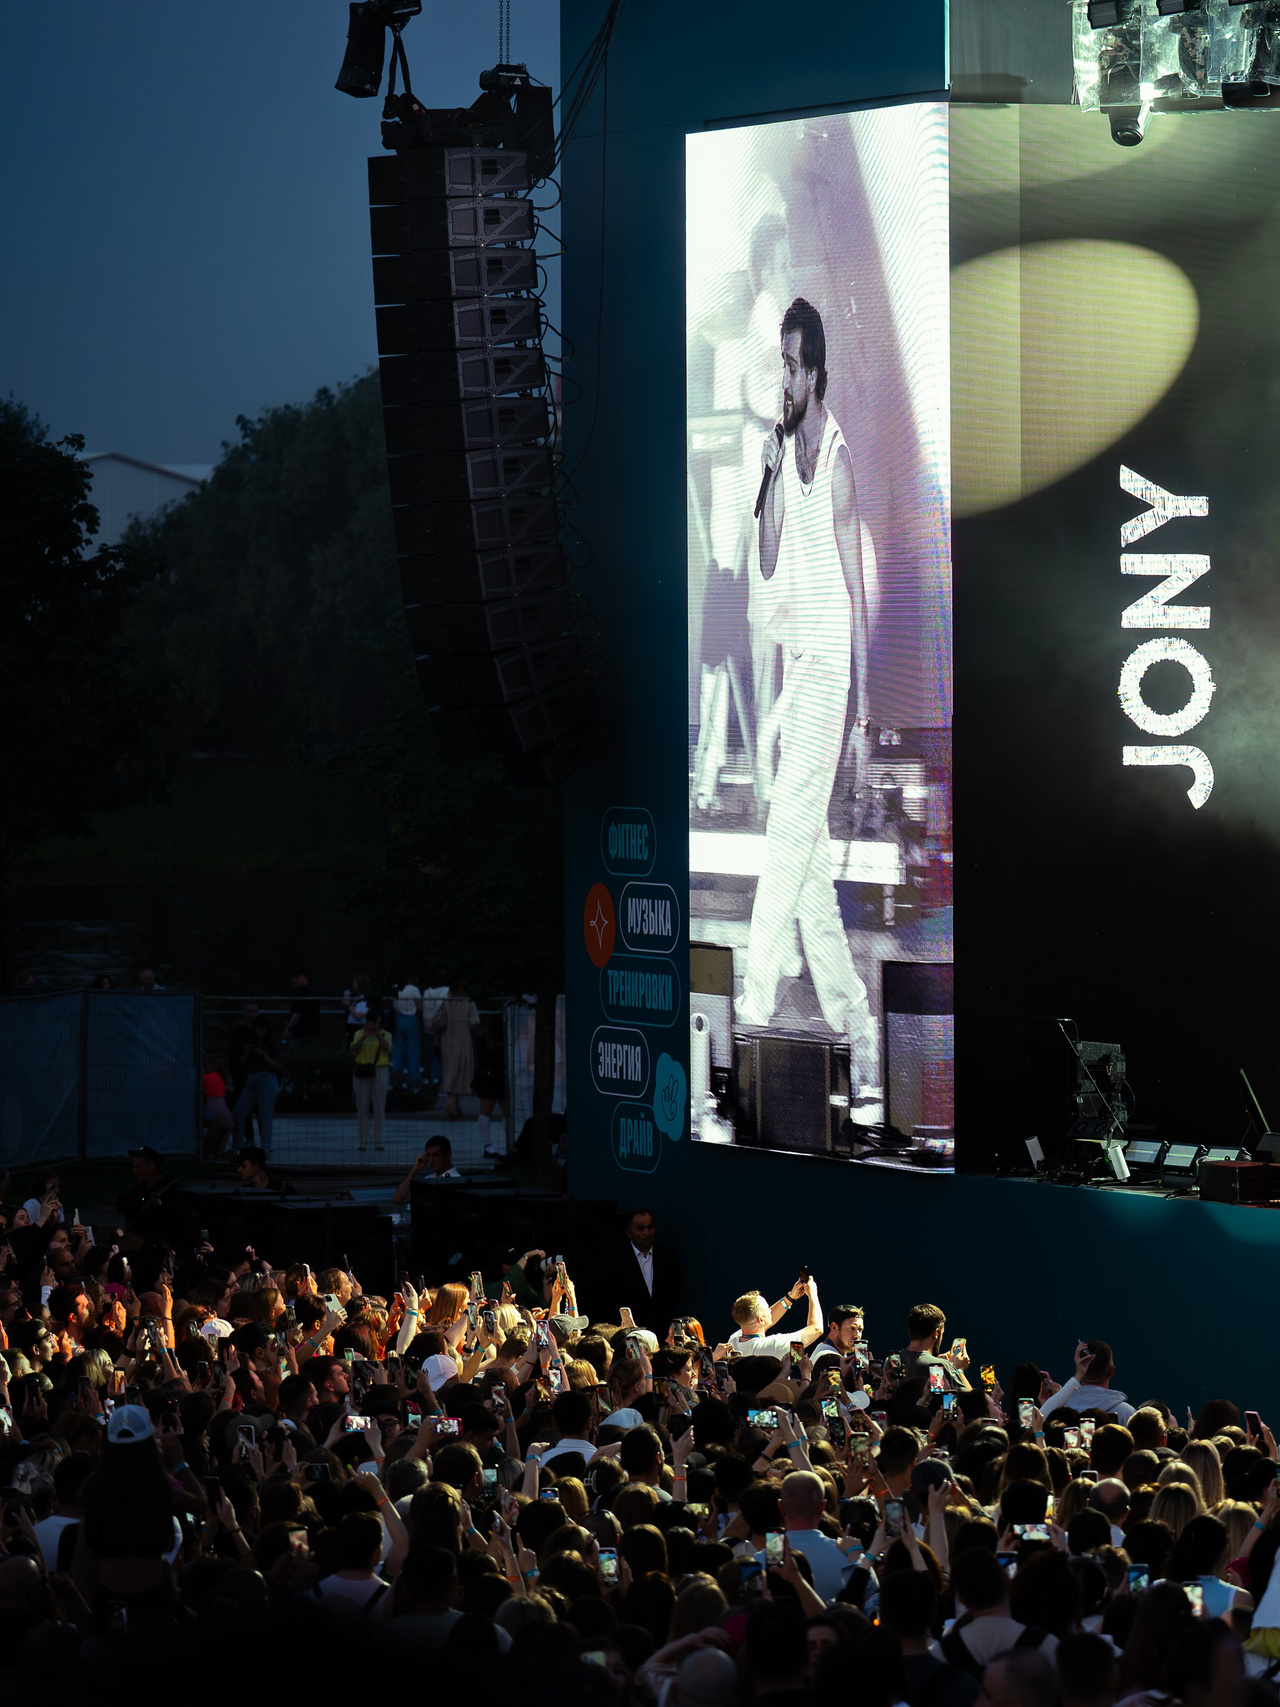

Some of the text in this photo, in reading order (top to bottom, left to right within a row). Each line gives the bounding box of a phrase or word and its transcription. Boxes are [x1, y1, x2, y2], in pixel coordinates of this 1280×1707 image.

[1118, 464, 1216, 809] JONY
[608, 821, 649, 861] ФИТНЕС
[627, 897, 672, 937] МУЗЫКА
[607, 969, 673, 1012] ТРЕНИРОВКИ
[598, 1041, 642, 1082] ЭНЕРГИЯ
[619, 1114, 654, 1158] ДРАЙВ
